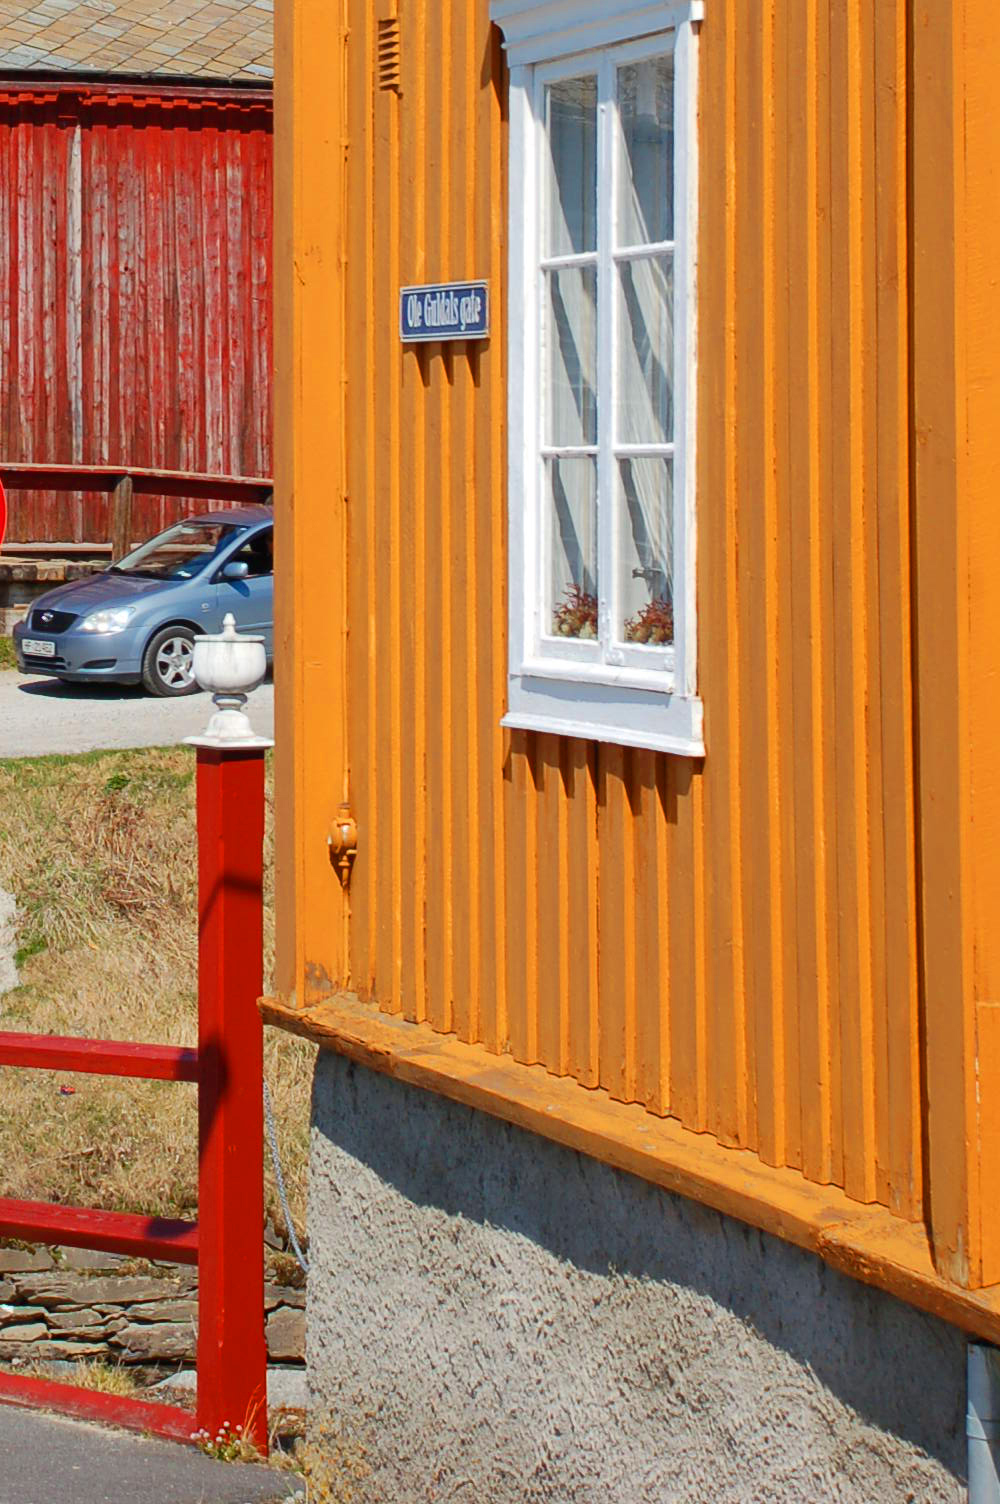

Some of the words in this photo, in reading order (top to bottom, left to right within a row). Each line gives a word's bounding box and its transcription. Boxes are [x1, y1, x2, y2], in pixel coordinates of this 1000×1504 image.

[407, 294, 422, 327] Ole
[424, 291, 459, 327] Guldals
[460, 289, 481, 331] gate
